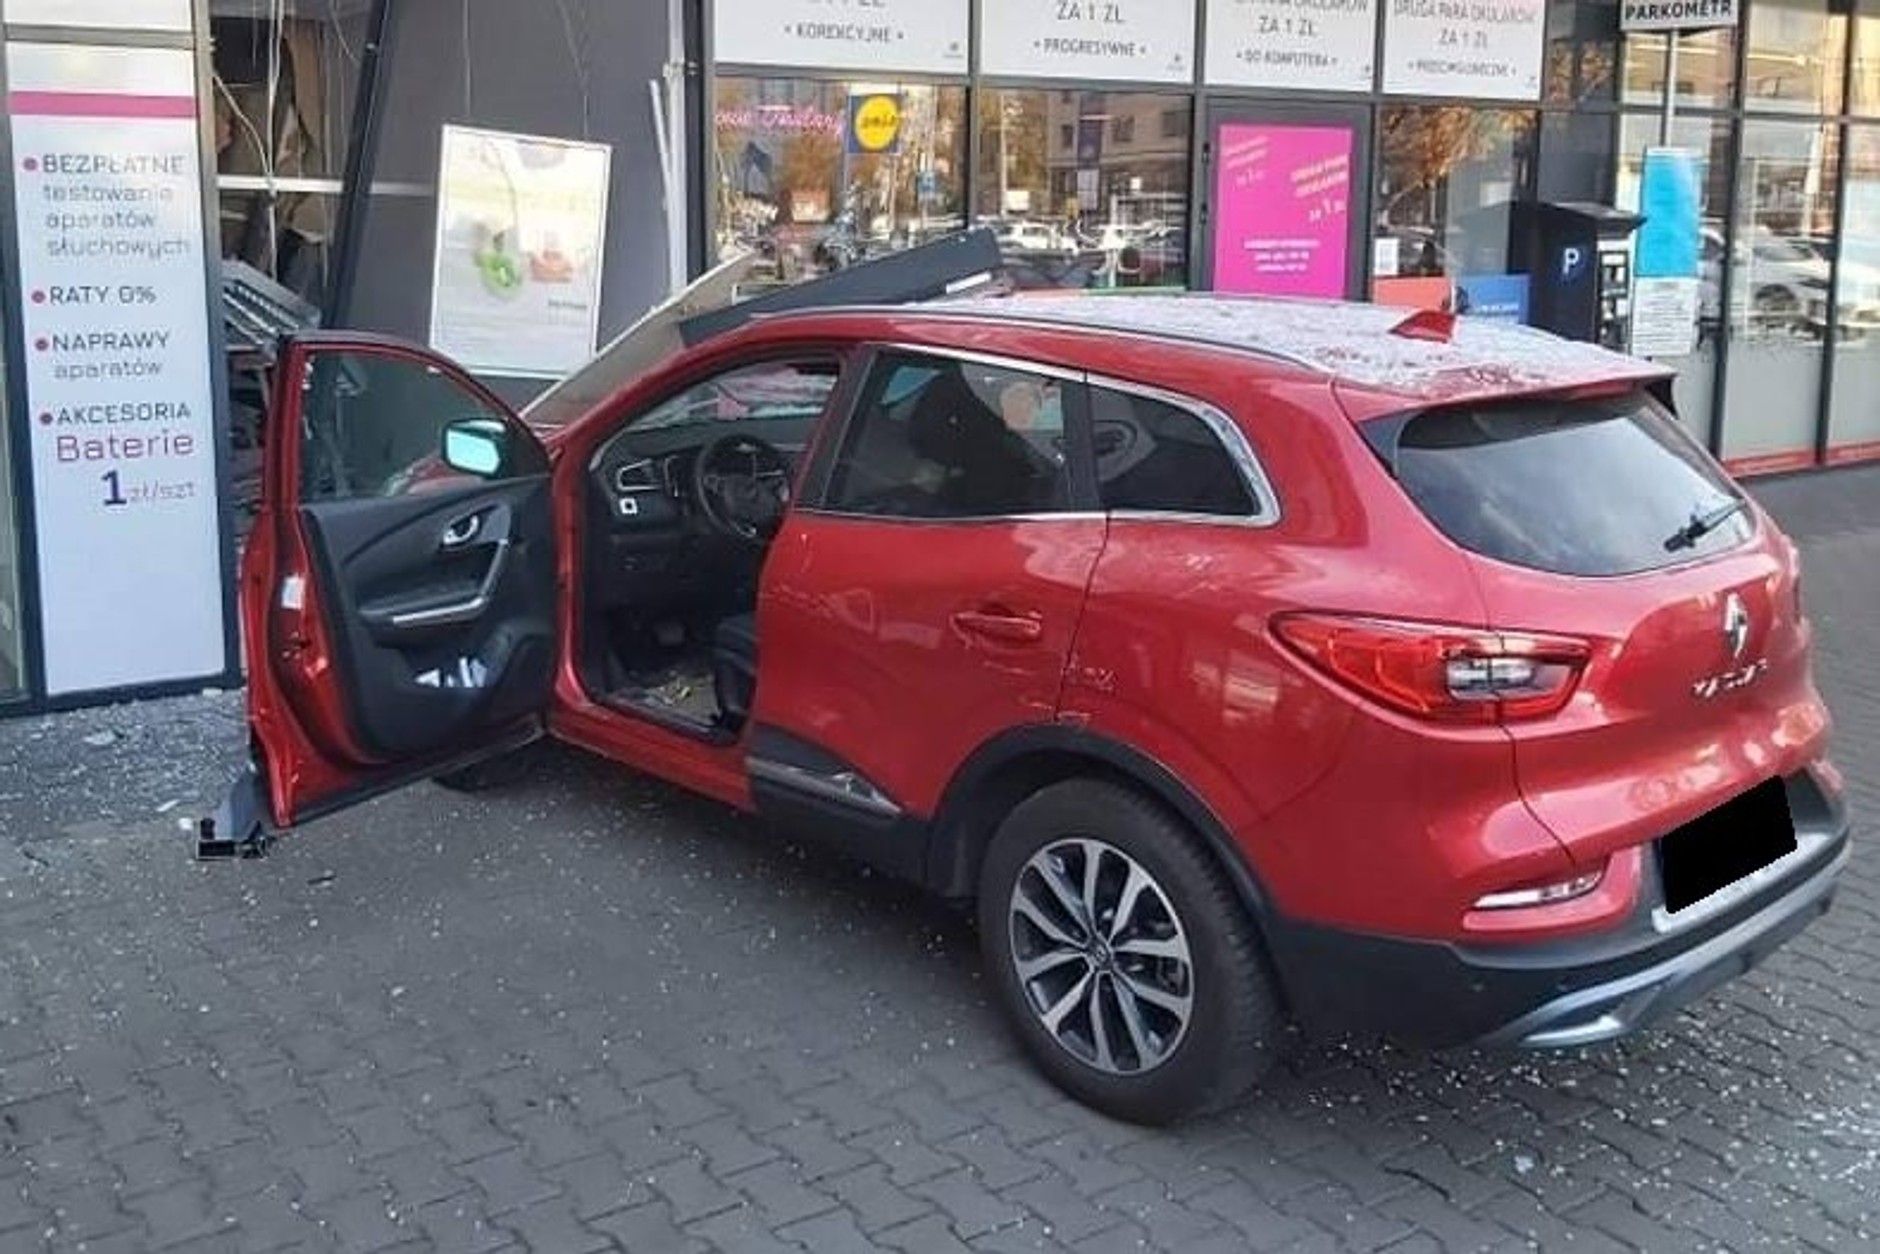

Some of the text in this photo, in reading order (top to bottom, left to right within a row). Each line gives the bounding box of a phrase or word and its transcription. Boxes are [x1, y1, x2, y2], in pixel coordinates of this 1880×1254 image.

[1057, 0, 1081, 21] ZA
[1625, 0, 1732, 20] PARKOMETR
[796, 22, 891, 43] KOREKCYJNE
[1043, 38, 1136, 56] PROGRESYWNE
[42, 154, 186, 175] BEZPŁATNE
[46, 211, 155, 233] aparatów
[1562, 248, 1579, 275] P
[50, 286, 156, 304] RATY 0%
[52, 331, 169, 351] NAPRAWY
[54, 358, 162, 380] aparatów
[57, 402, 191, 424] AKCESORIA
[57, 428, 194, 462] Baterie
